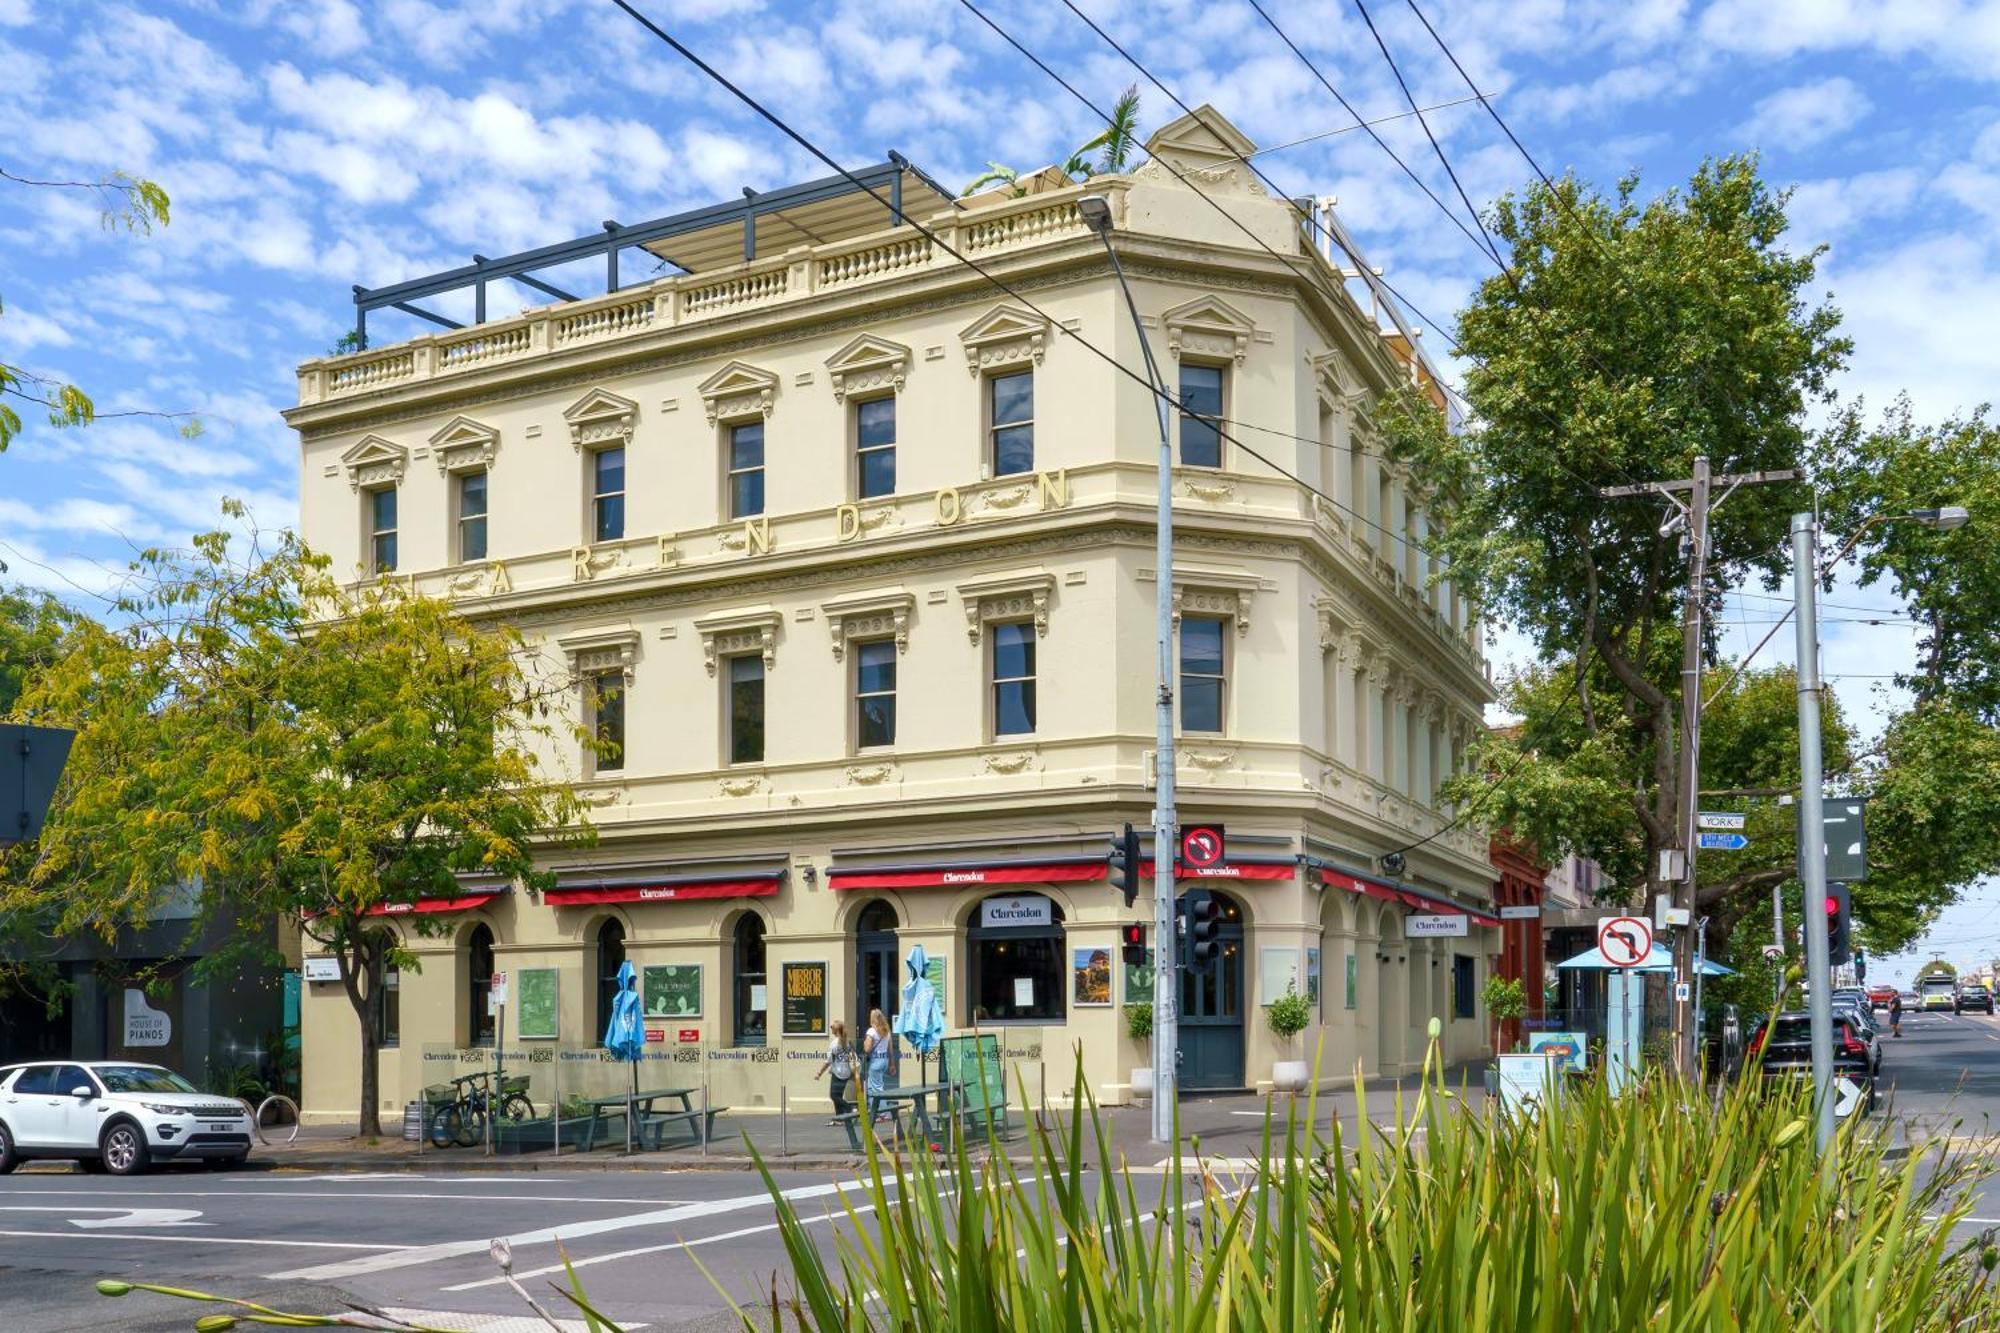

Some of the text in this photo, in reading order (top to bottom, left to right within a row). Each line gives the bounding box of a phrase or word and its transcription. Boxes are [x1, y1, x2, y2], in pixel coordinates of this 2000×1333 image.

[1706, 817, 1733, 826] YORK
[943, 871, 984, 883] Clarendon
[990, 907, 1042, 919] Clarendon
[1416, 921, 1457, 930] Clarendon
[788, 968, 822, 983] MIRROR
[788, 983, 822, 997] MIRROR
[130, 1020, 163, 1028] HOUSE OF
[130, 1030, 164, 1040] PIANOS
[490, 1051, 526, 1061] Crendon
[679, 1052, 700, 1062] GOAT
[708, 1050, 747, 1060] Clarendon
[756, 1053, 779, 1062] GOAT
[786, 1049, 828, 1060] Clarendon
